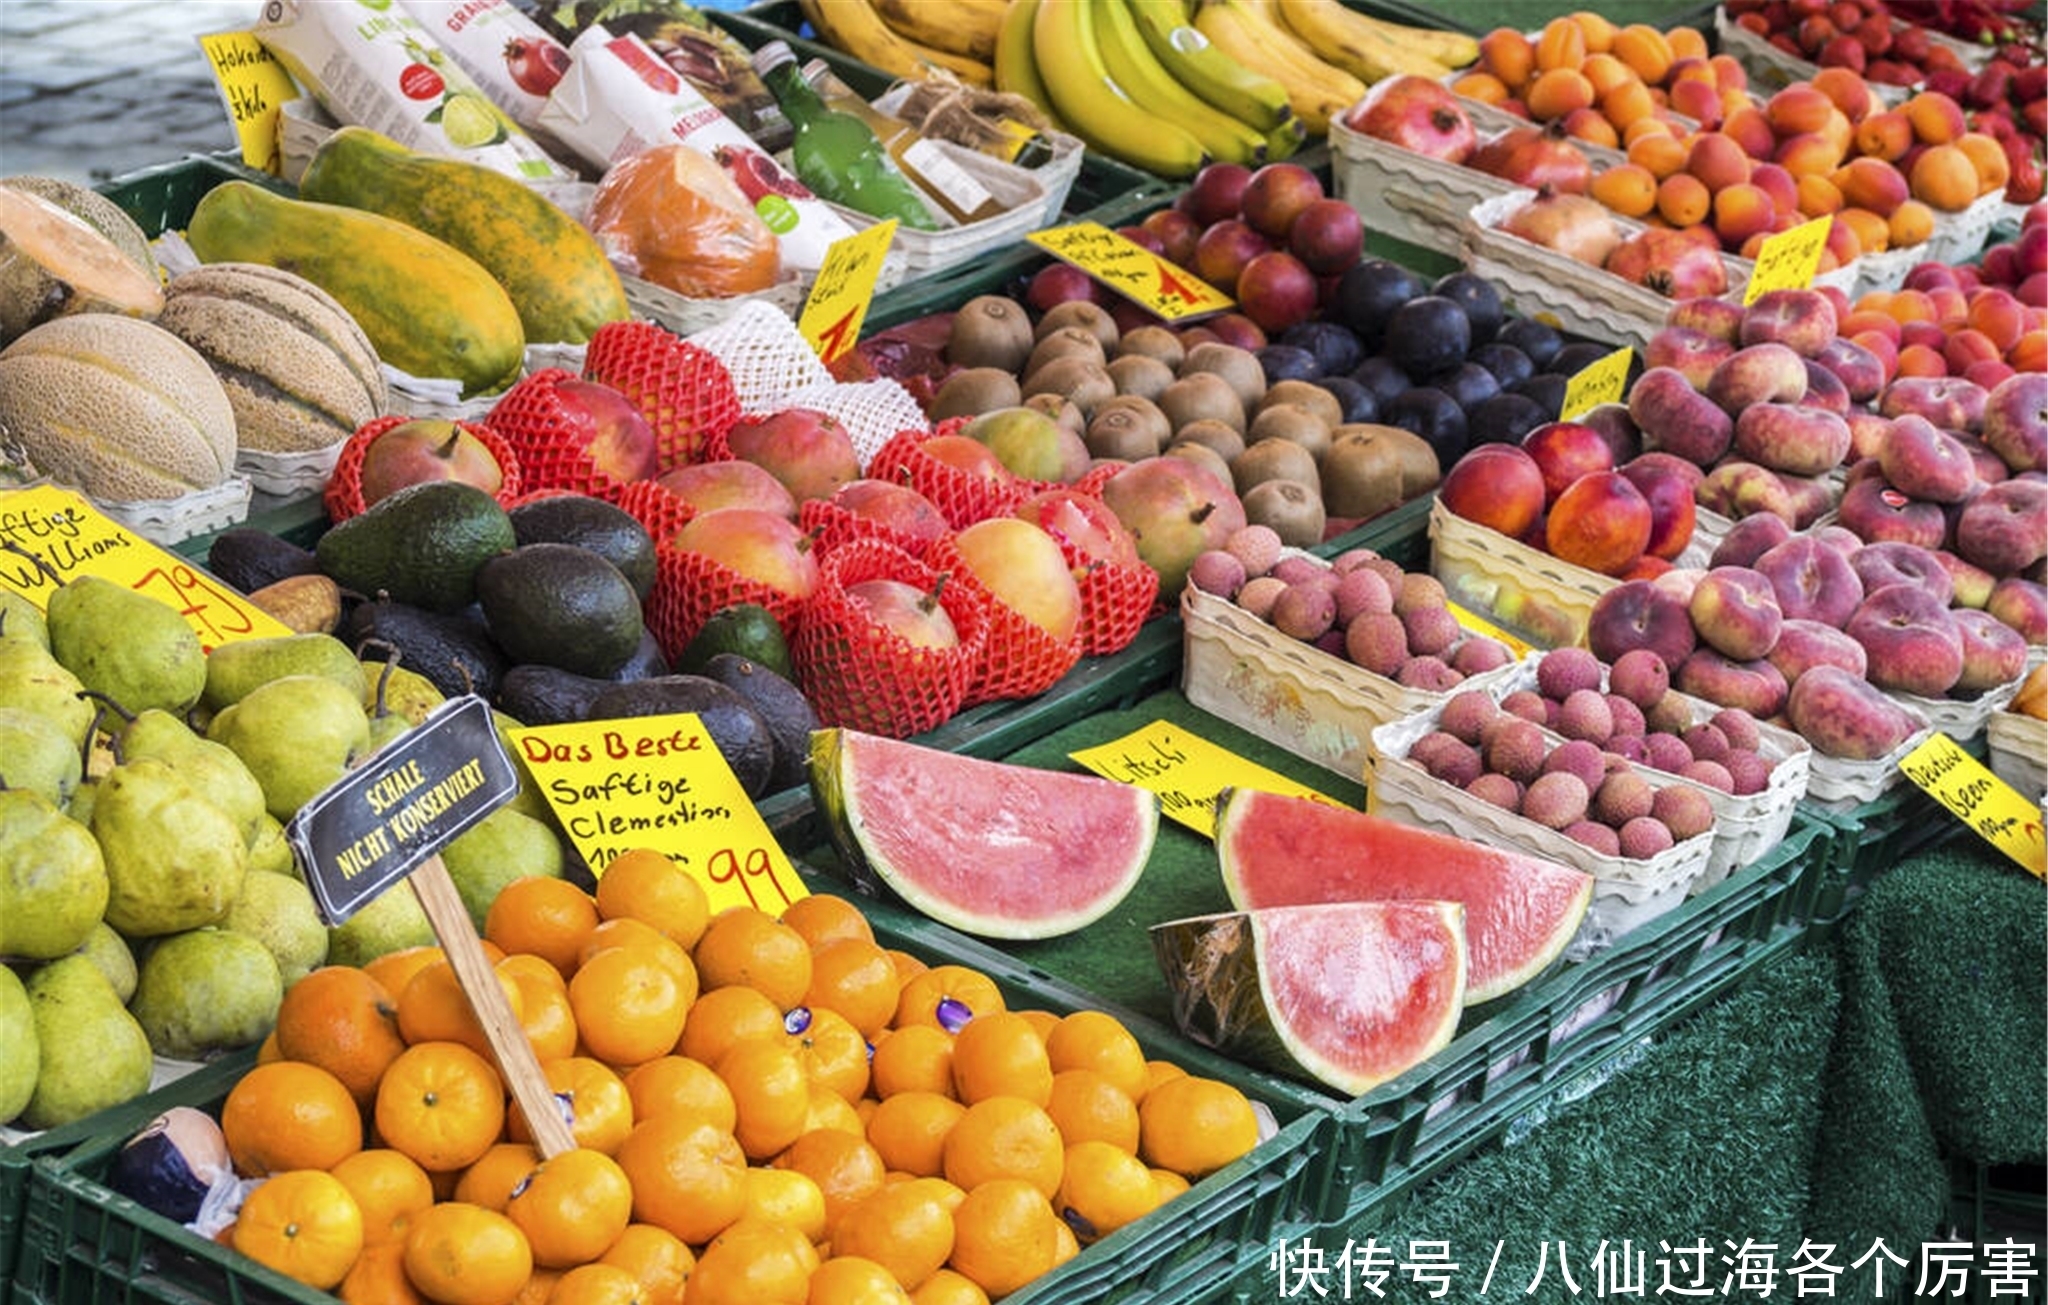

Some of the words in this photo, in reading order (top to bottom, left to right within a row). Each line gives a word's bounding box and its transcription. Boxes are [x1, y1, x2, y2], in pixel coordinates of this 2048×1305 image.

[521, 736, 592, 763] Das
[603, 730, 701, 759] Beste
[1096, 736, 1187, 784] Litschi
[365, 759, 426, 816] SCHALE
[551, 773, 691, 805] Saftige
[335, 826, 391, 881] NICHT
[389, 758, 486, 843] KONSERVIERT
